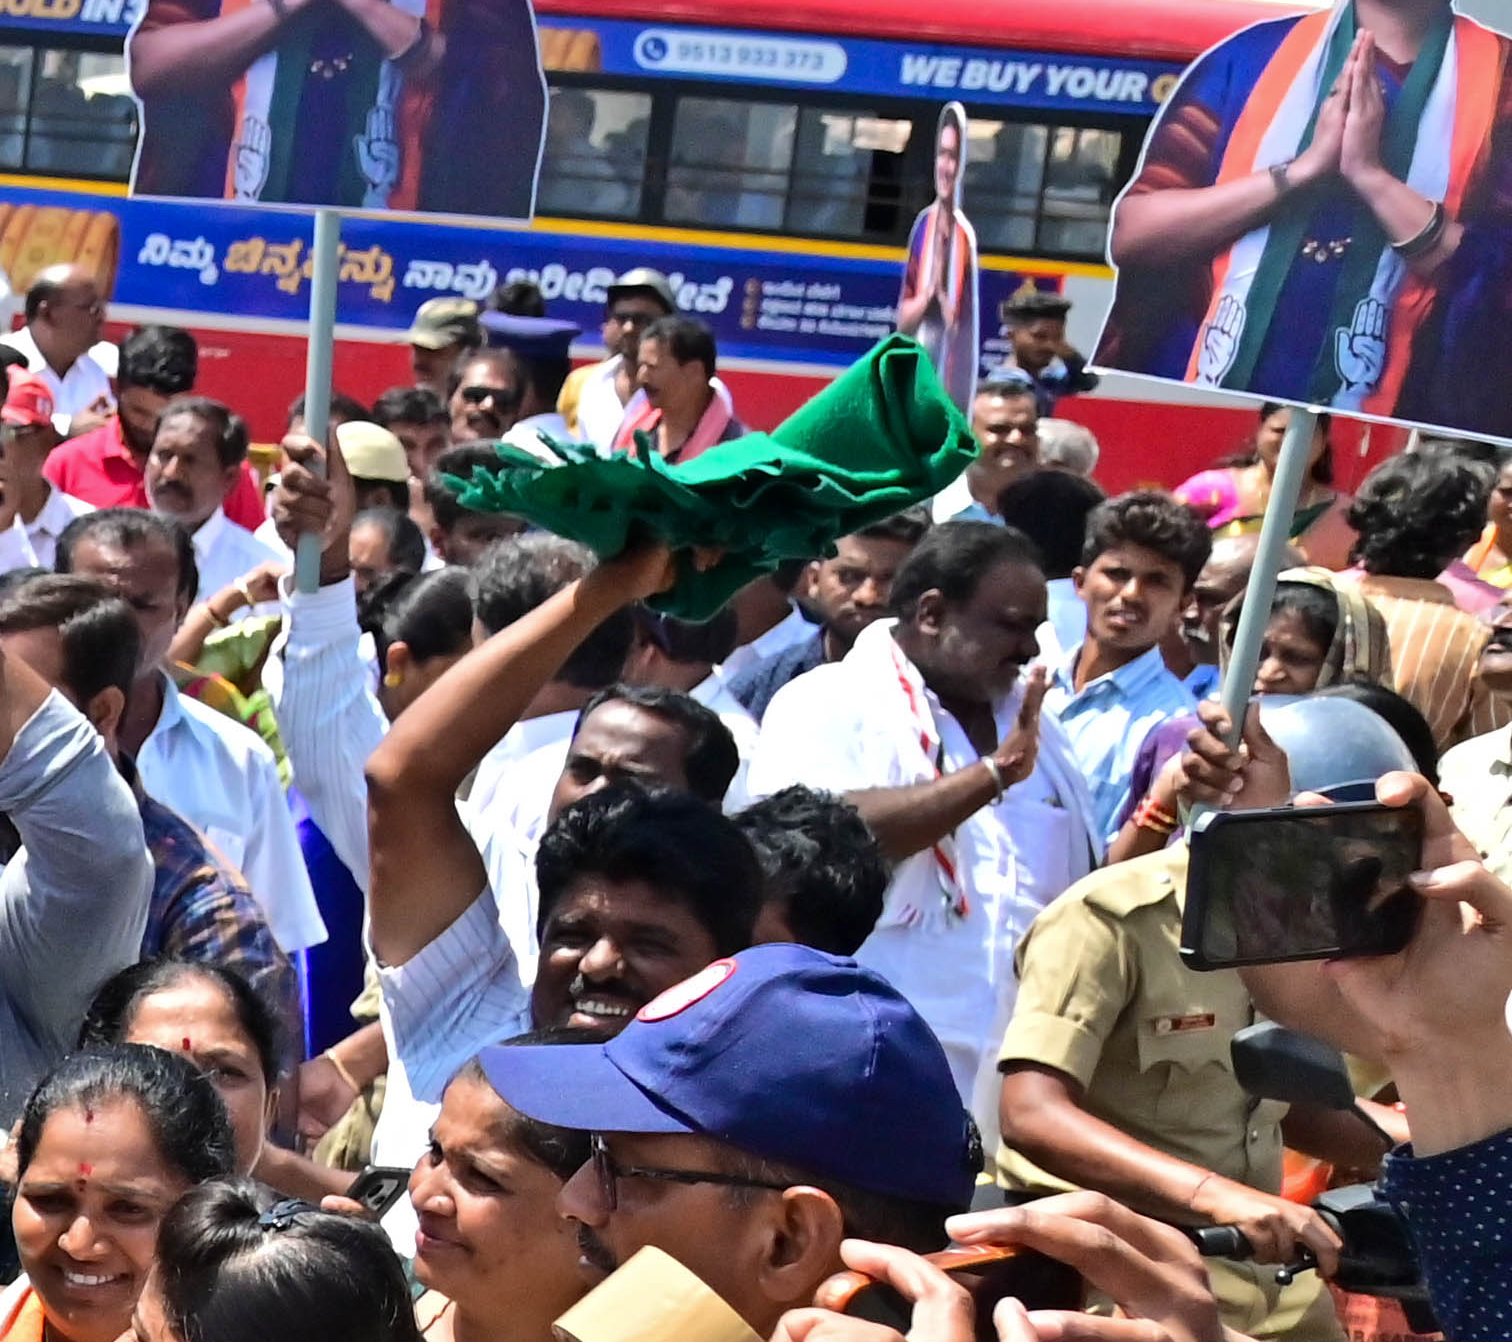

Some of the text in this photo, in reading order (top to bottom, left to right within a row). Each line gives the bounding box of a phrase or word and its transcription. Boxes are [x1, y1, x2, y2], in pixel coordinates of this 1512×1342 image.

[676, 39, 826, 71] 9513 933 373
[900, 54, 966, 88] WE
[963, 58, 1041, 95] BUY
[1041, 64, 1149, 104] YOUR
[137, 232, 220, 287] ನಿಮ್ಮ
[224, 236, 396, 304] ಚಿನ್ನನ್ನು
[402, 258, 498, 301] ನಾವು
